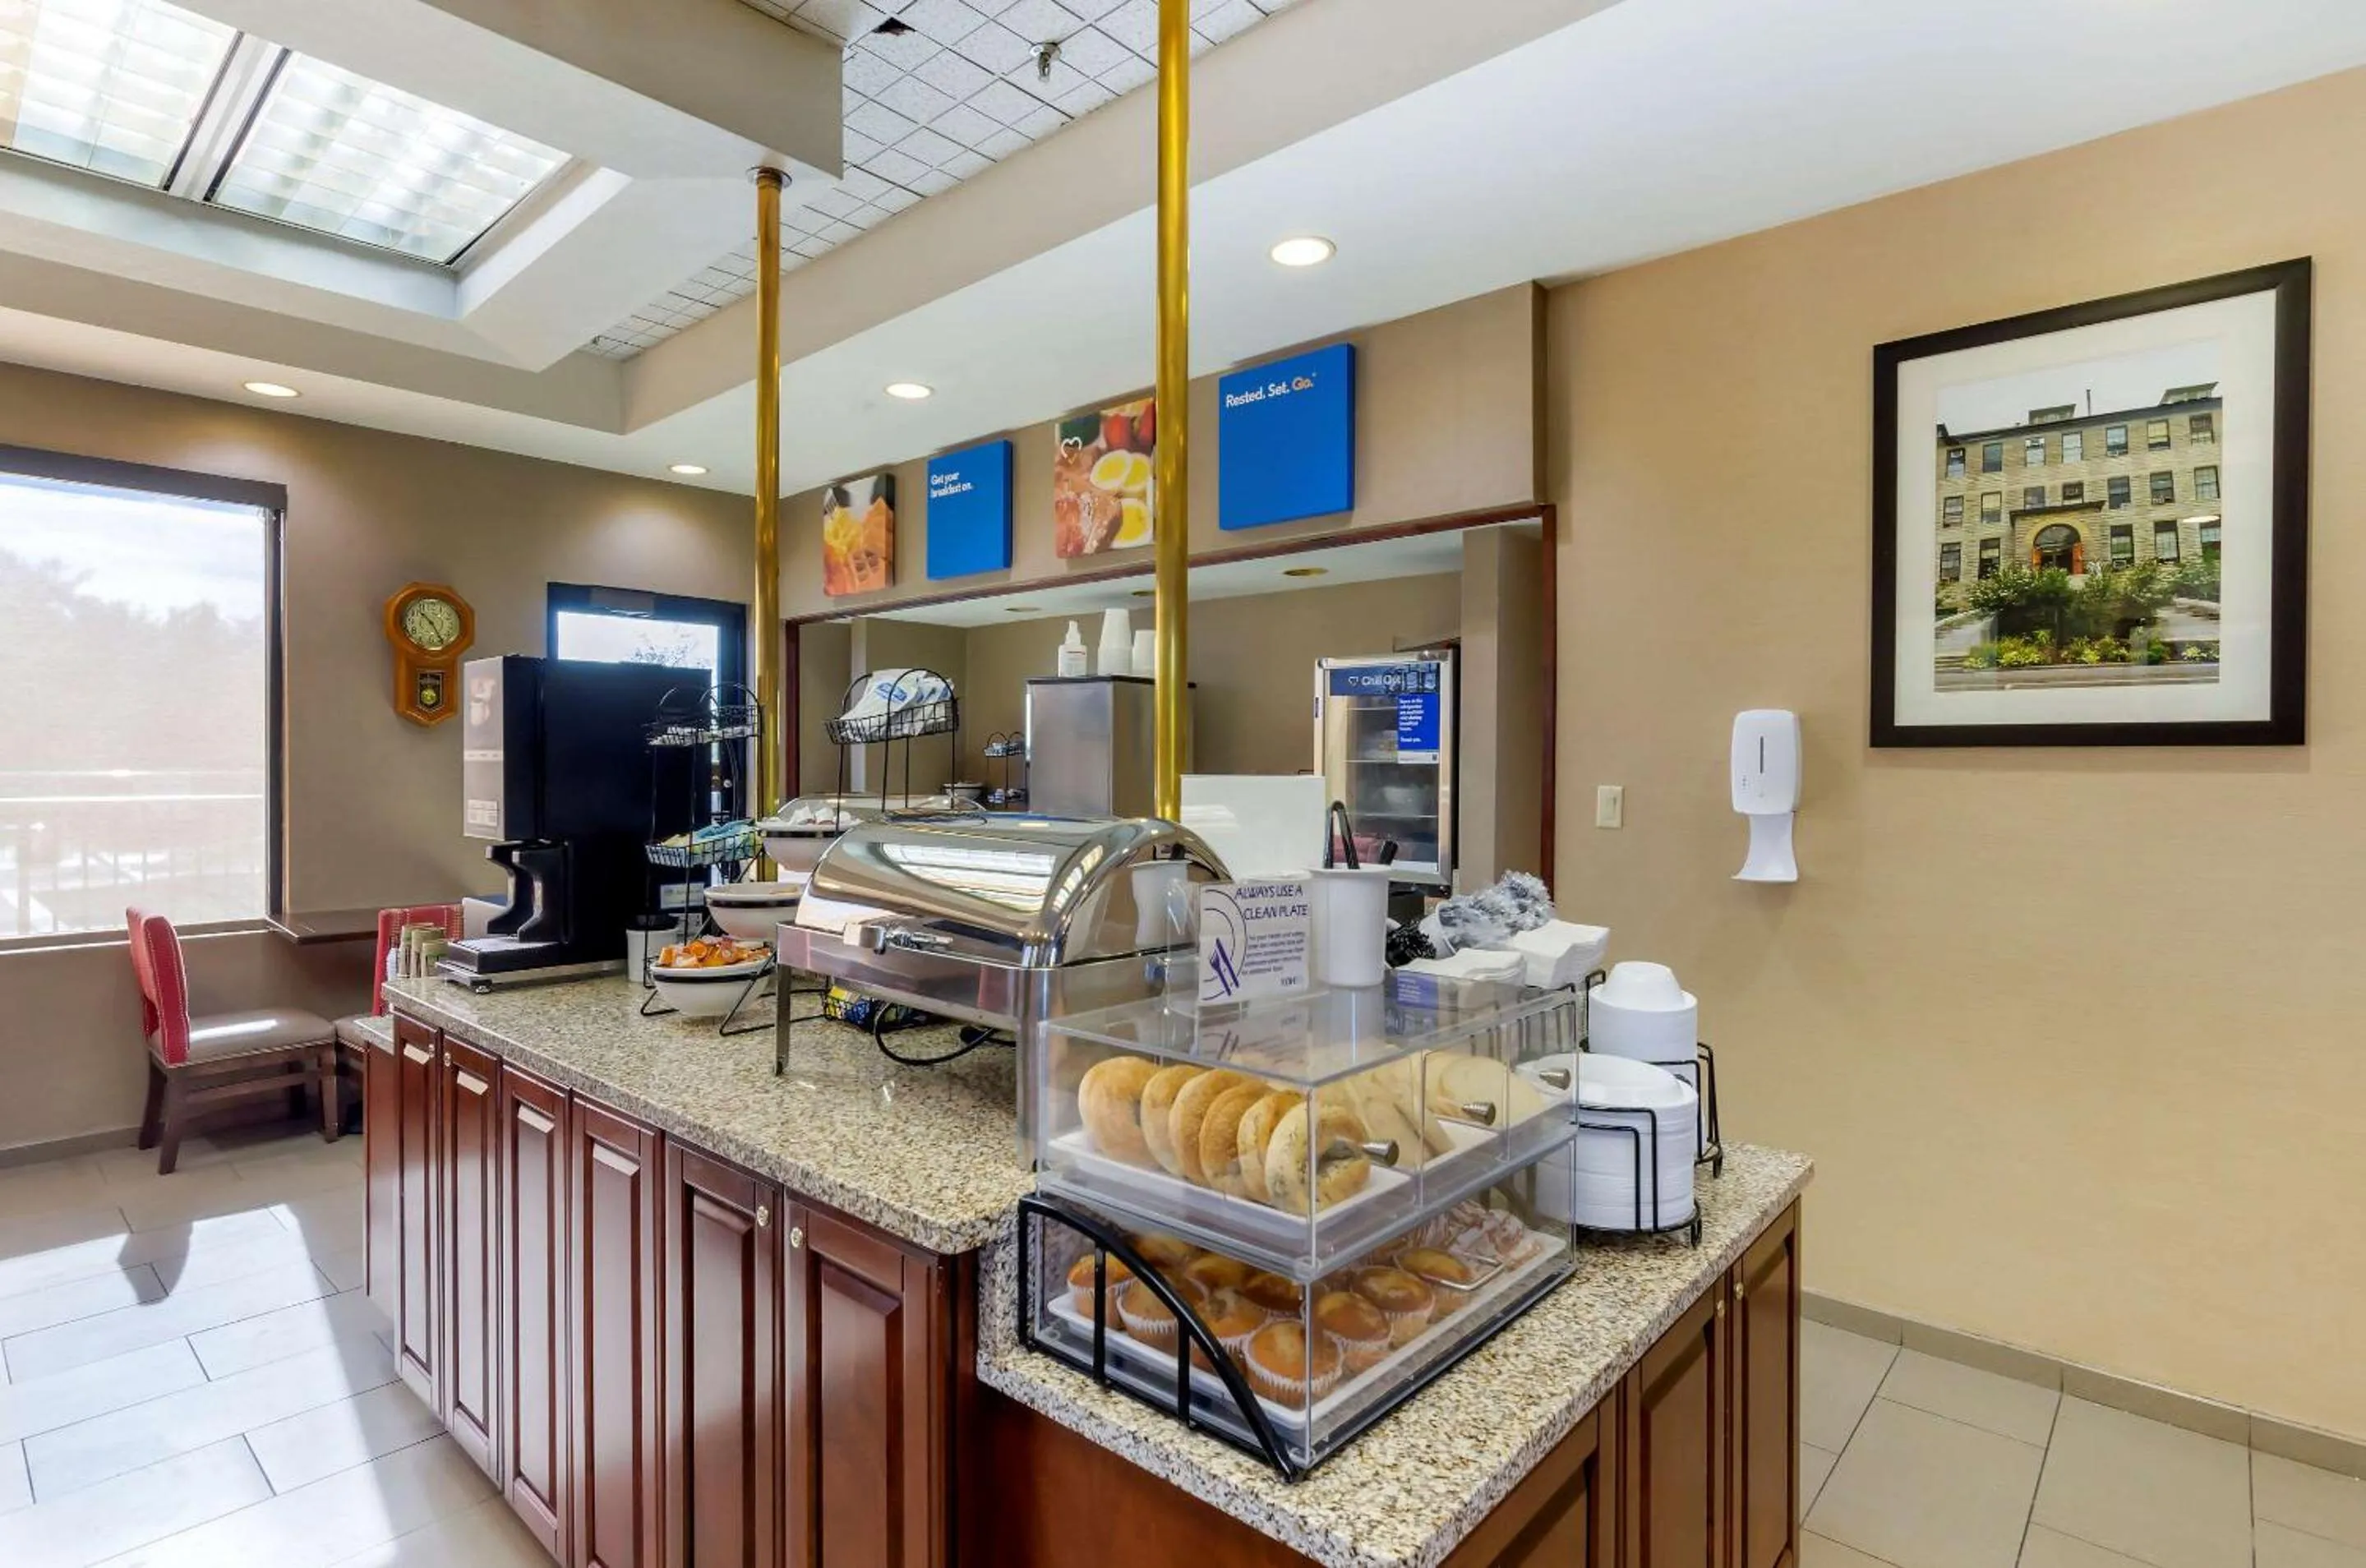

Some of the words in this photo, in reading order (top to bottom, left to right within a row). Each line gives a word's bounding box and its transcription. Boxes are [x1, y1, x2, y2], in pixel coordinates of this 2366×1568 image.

[1226, 385, 1266, 408] Rested.
[1268, 381, 1290, 397] Set.
[1292, 376, 1314, 390] Go.
[930, 474, 944, 486] Get
[944, 472, 960, 485] your
[930, 483, 961, 498] breakfast
[962, 482, 974, 491] on.
[1234, 886, 1275, 900] ALWAYS
[1276, 885, 1294, 897] USE
[1295, 884, 1303, 897] A
[1243, 906, 1277, 920] CLEAN
[1279, 905, 1308, 918] PLATE
